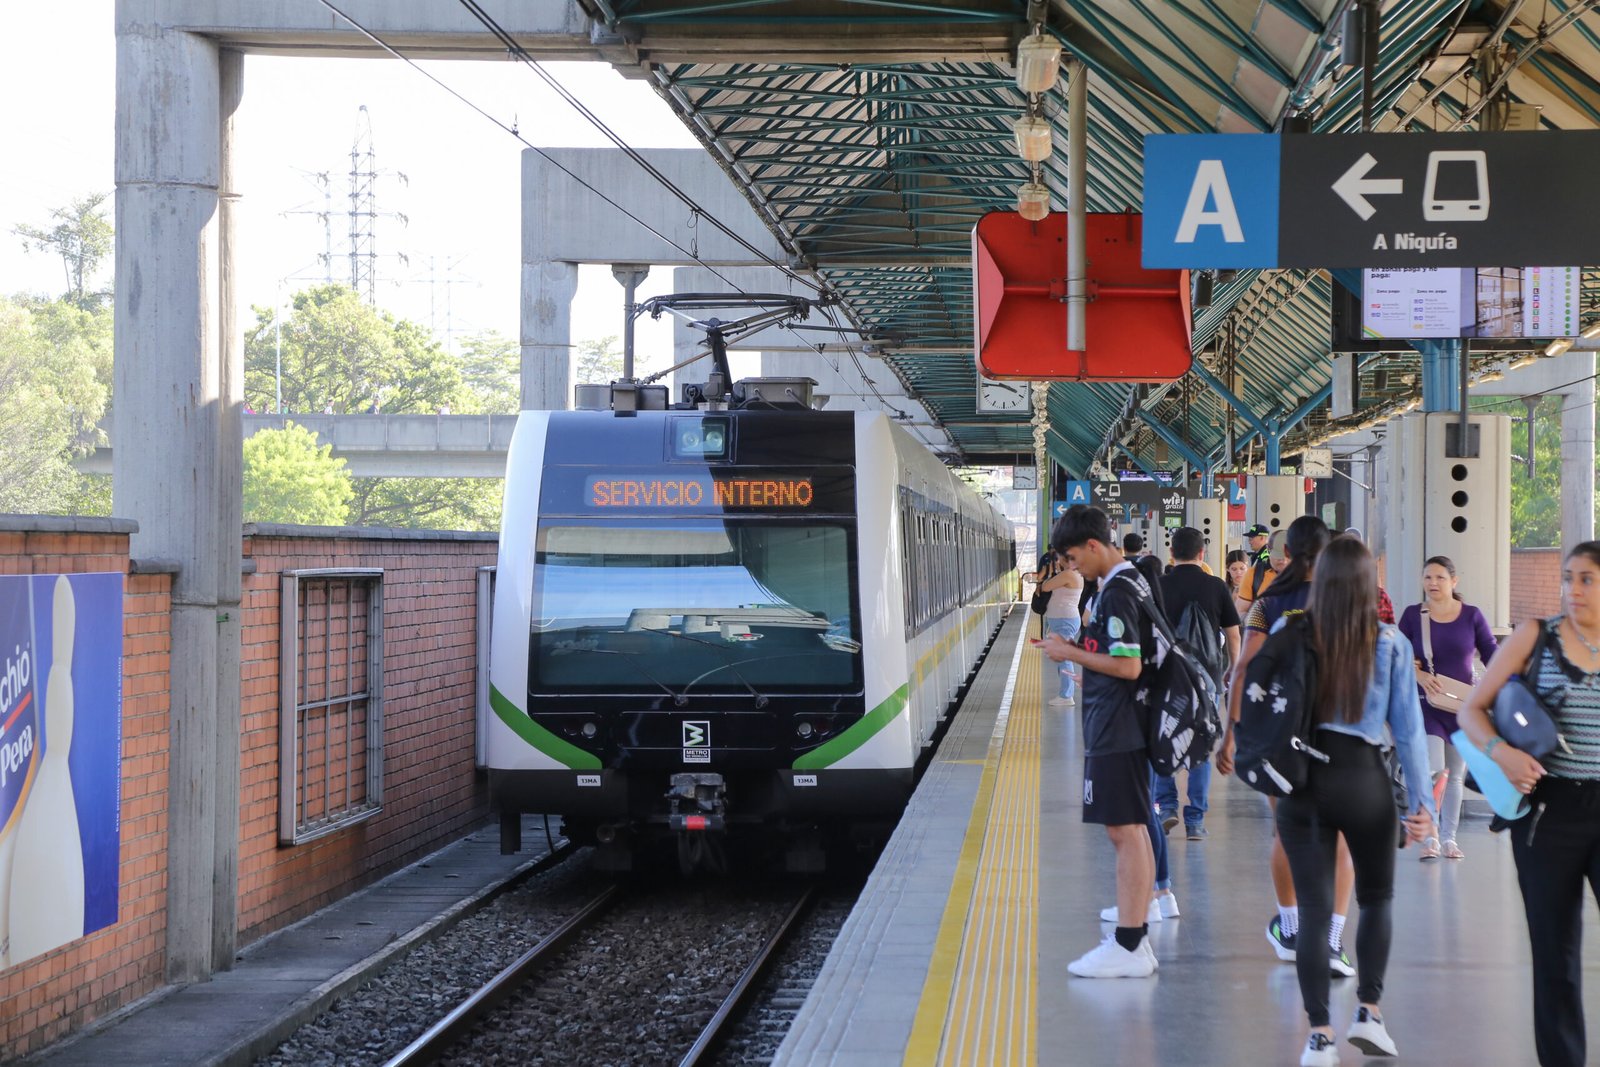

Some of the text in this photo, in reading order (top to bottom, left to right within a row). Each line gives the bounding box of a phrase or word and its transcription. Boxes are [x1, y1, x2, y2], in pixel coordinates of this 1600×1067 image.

[1174, 159, 1246, 243] A
[1373, 232, 1458, 253] A Niquía
[593, 481, 813, 506] SERVICIO INTERNO
[1072, 484, 1085, 500] A
